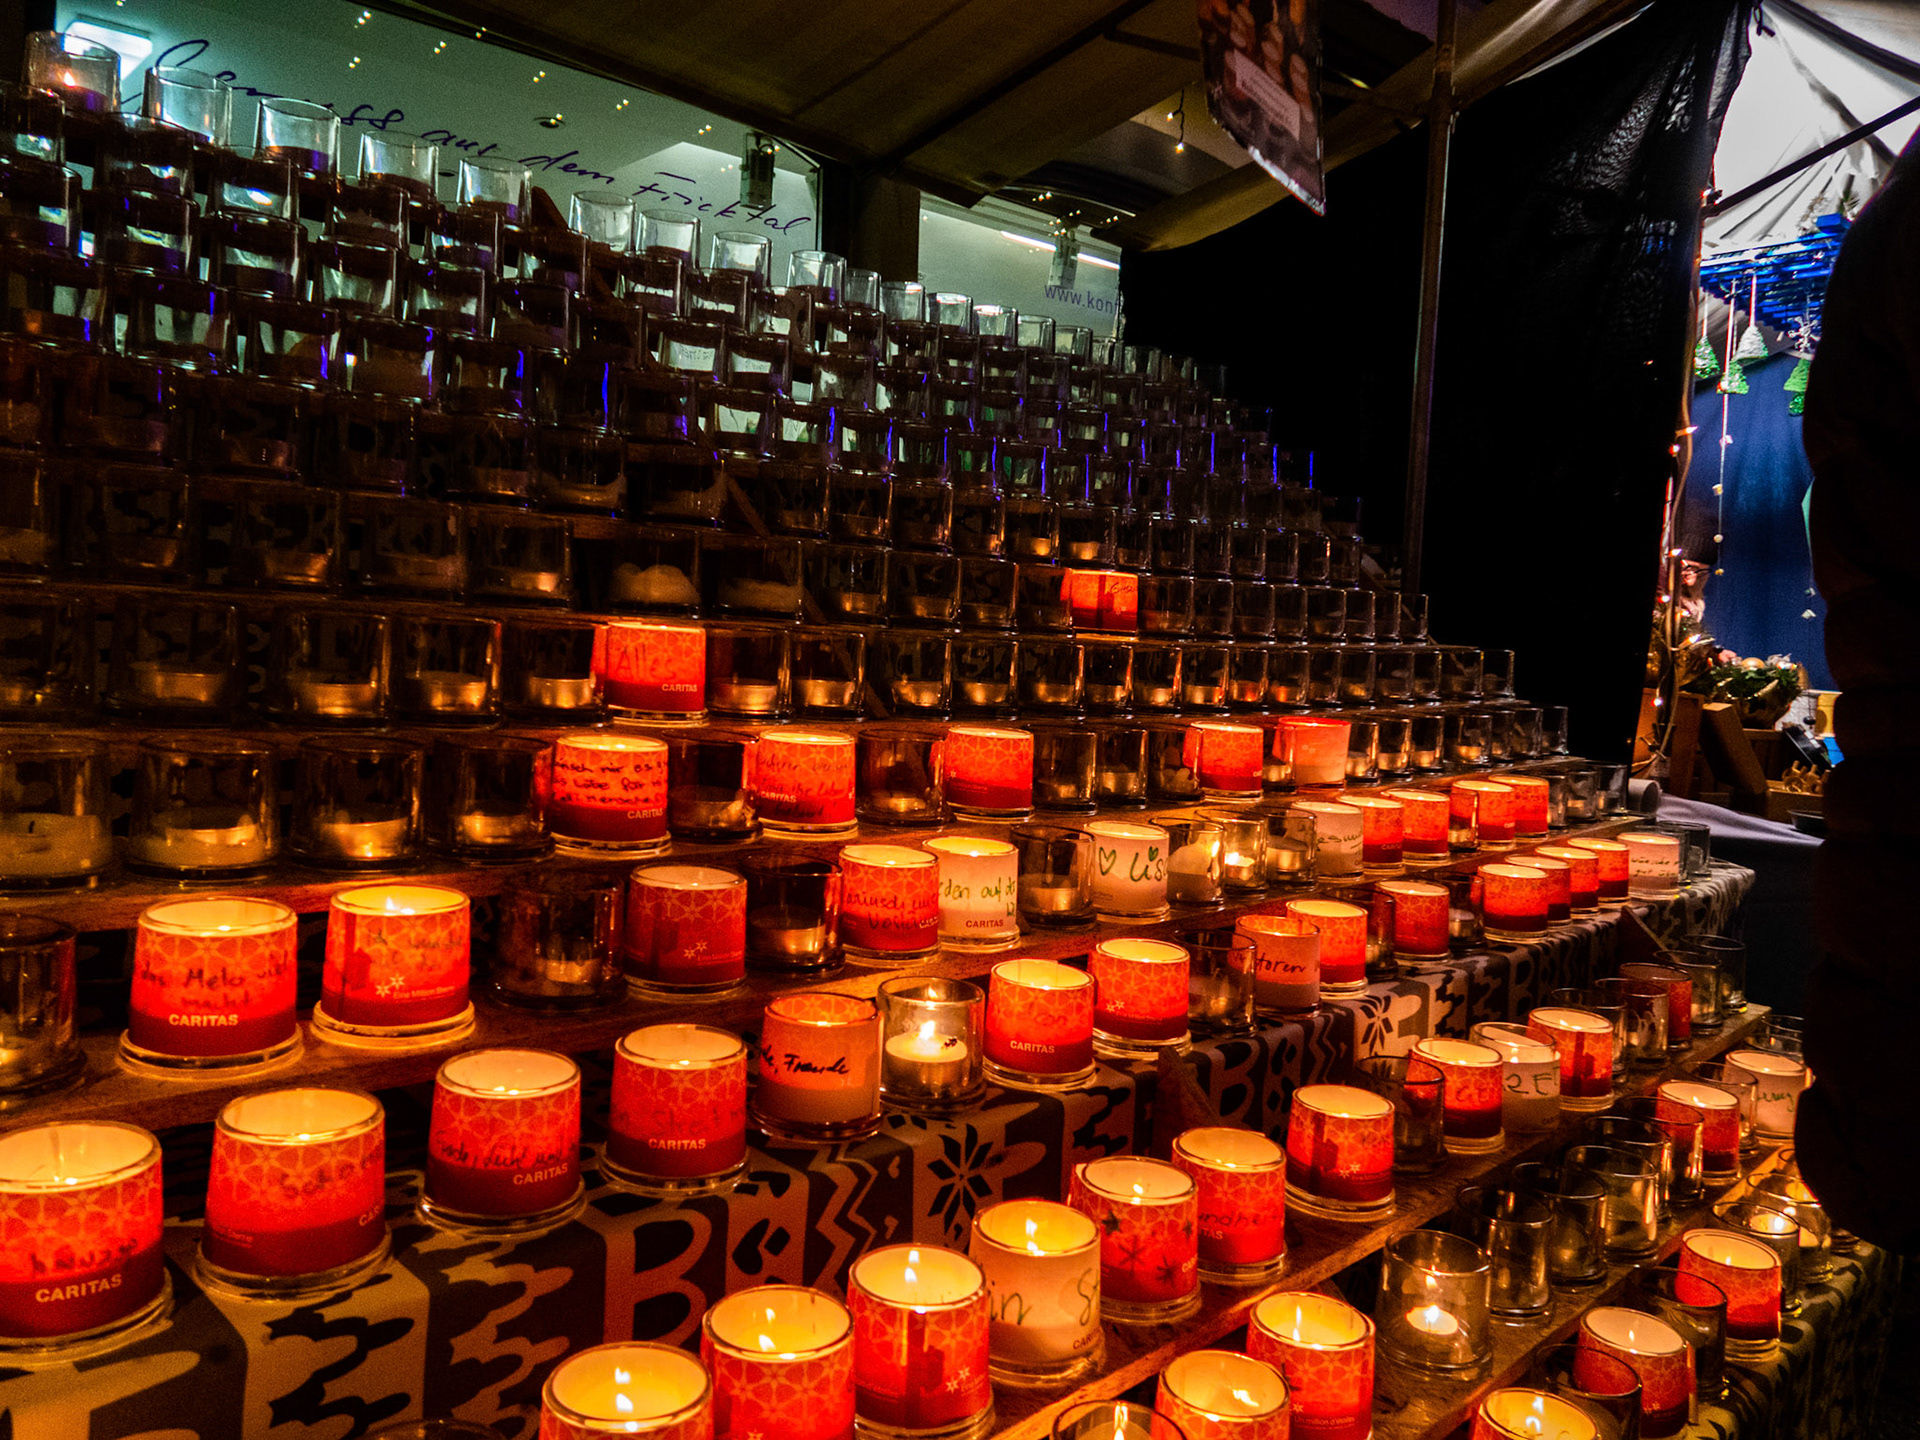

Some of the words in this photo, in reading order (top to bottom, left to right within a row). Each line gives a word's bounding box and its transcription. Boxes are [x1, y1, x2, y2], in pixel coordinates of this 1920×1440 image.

[518, 150, 615, 184] dem
[661, 683, 698, 693] CARITAS
[760, 790, 797, 803] CARITAS
[627, 808, 664, 820] CARITAS
[966, 919, 1004, 928] CARITAS
[168, 1013, 240, 1028] CARITAS
[1010, 1039, 1055, 1054] CARITAS
[648, 1138, 706, 1150] CARITAS
[512, 1162, 569, 1186] CARITAS
[35, 1273, 123, 1303] CARITAS
